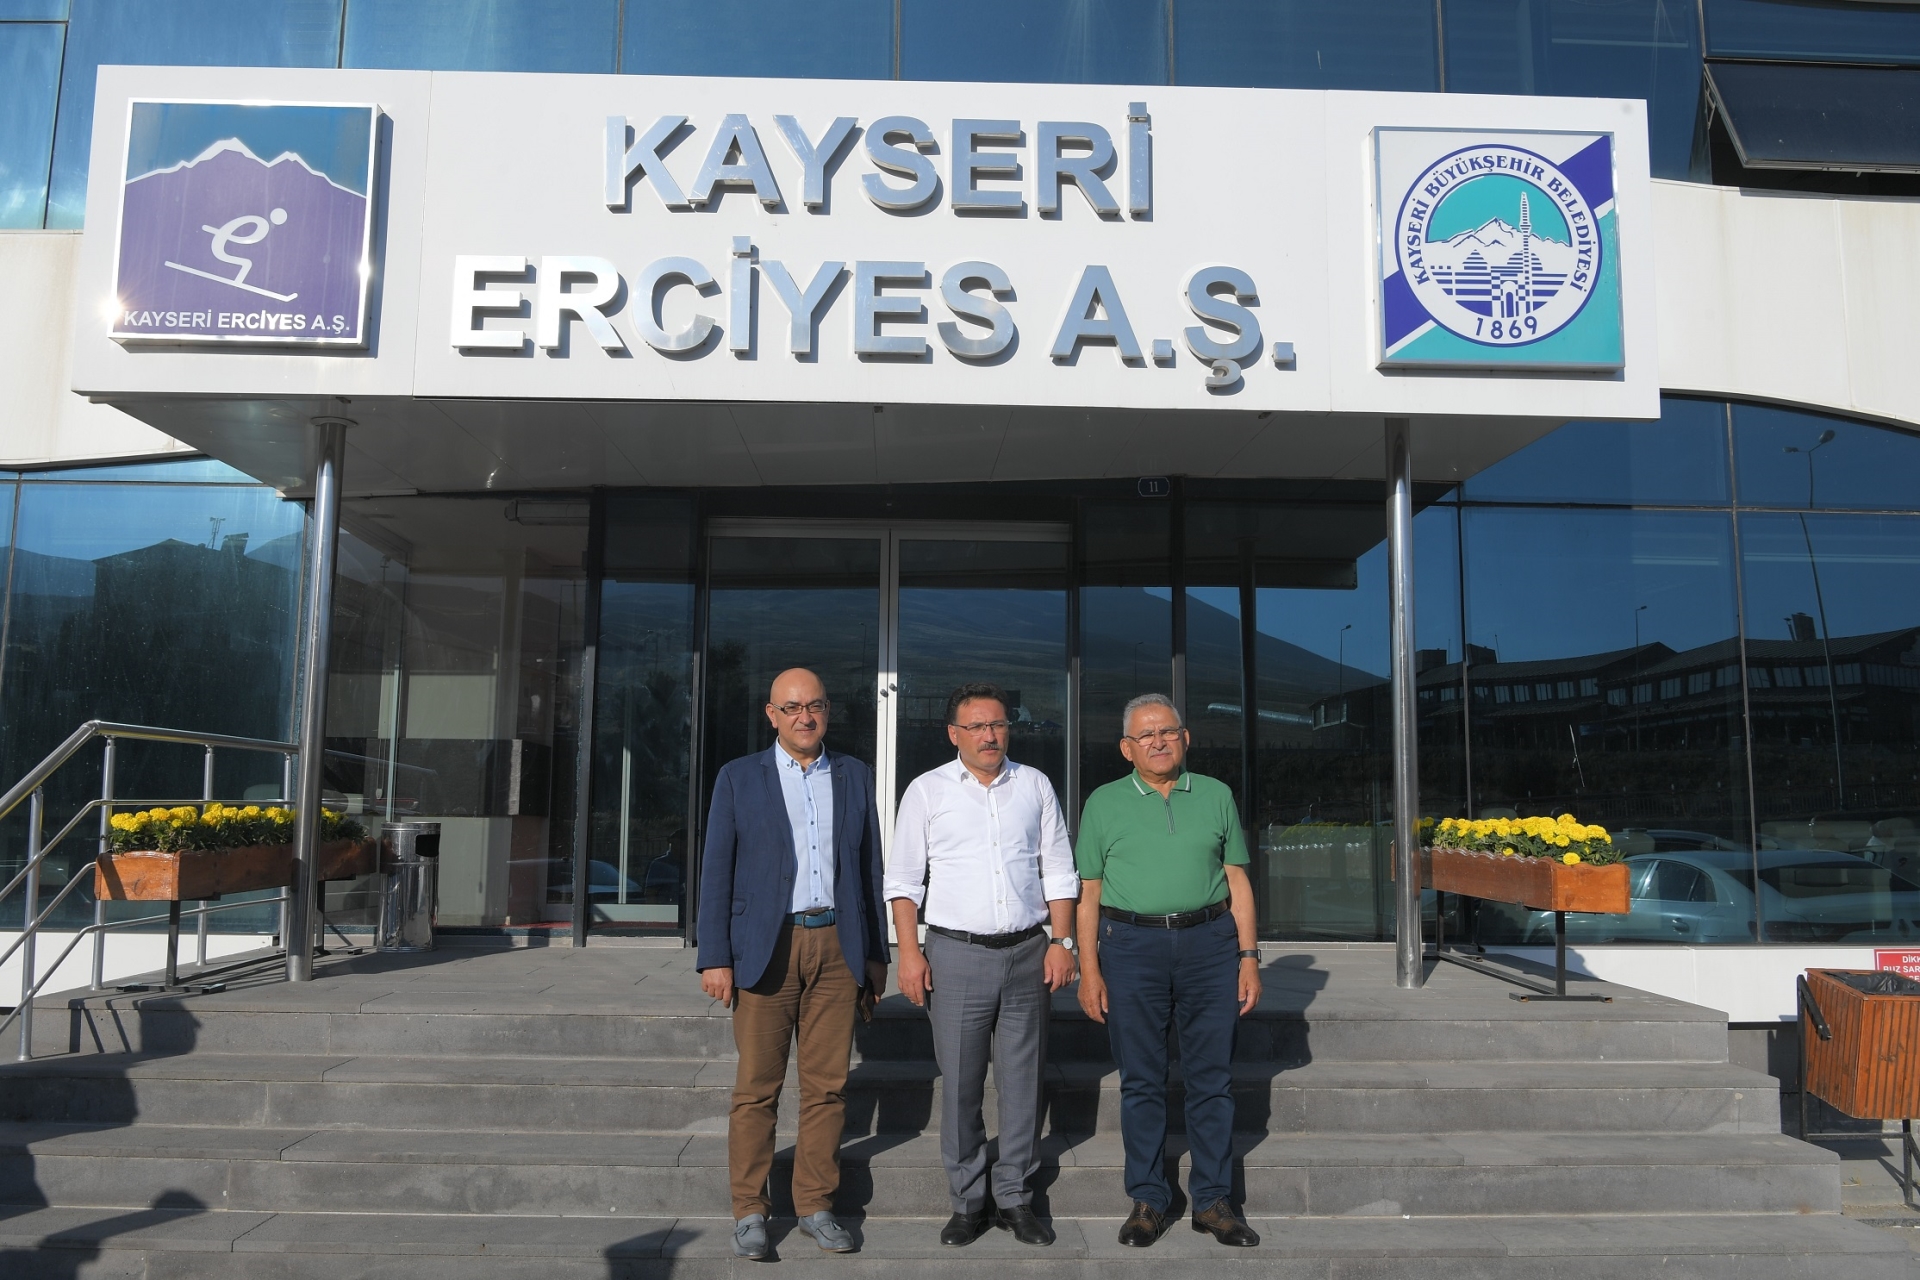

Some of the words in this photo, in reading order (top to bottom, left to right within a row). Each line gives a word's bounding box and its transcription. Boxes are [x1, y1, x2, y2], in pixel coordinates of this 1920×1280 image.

[604, 101, 1150, 215] KAYSERİ
[1406, 197, 1431, 286] KAYSERİ
[1423, 154, 1546, 199] BÜYÜKŞEHİR
[1546, 176, 1597, 294] BELEDİYESİ
[123, 309, 212, 328] KAYSERİ
[217, 309, 306, 330] ERCİYES
[311, 314, 350, 335] A.Ş.
[451, 235, 1015, 360] ERCİYES
[1049, 264, 1295, 389] A.Ş.
[1475, 315, 1539, 340] 1869
[1149, 481, 1159, 493] 11
